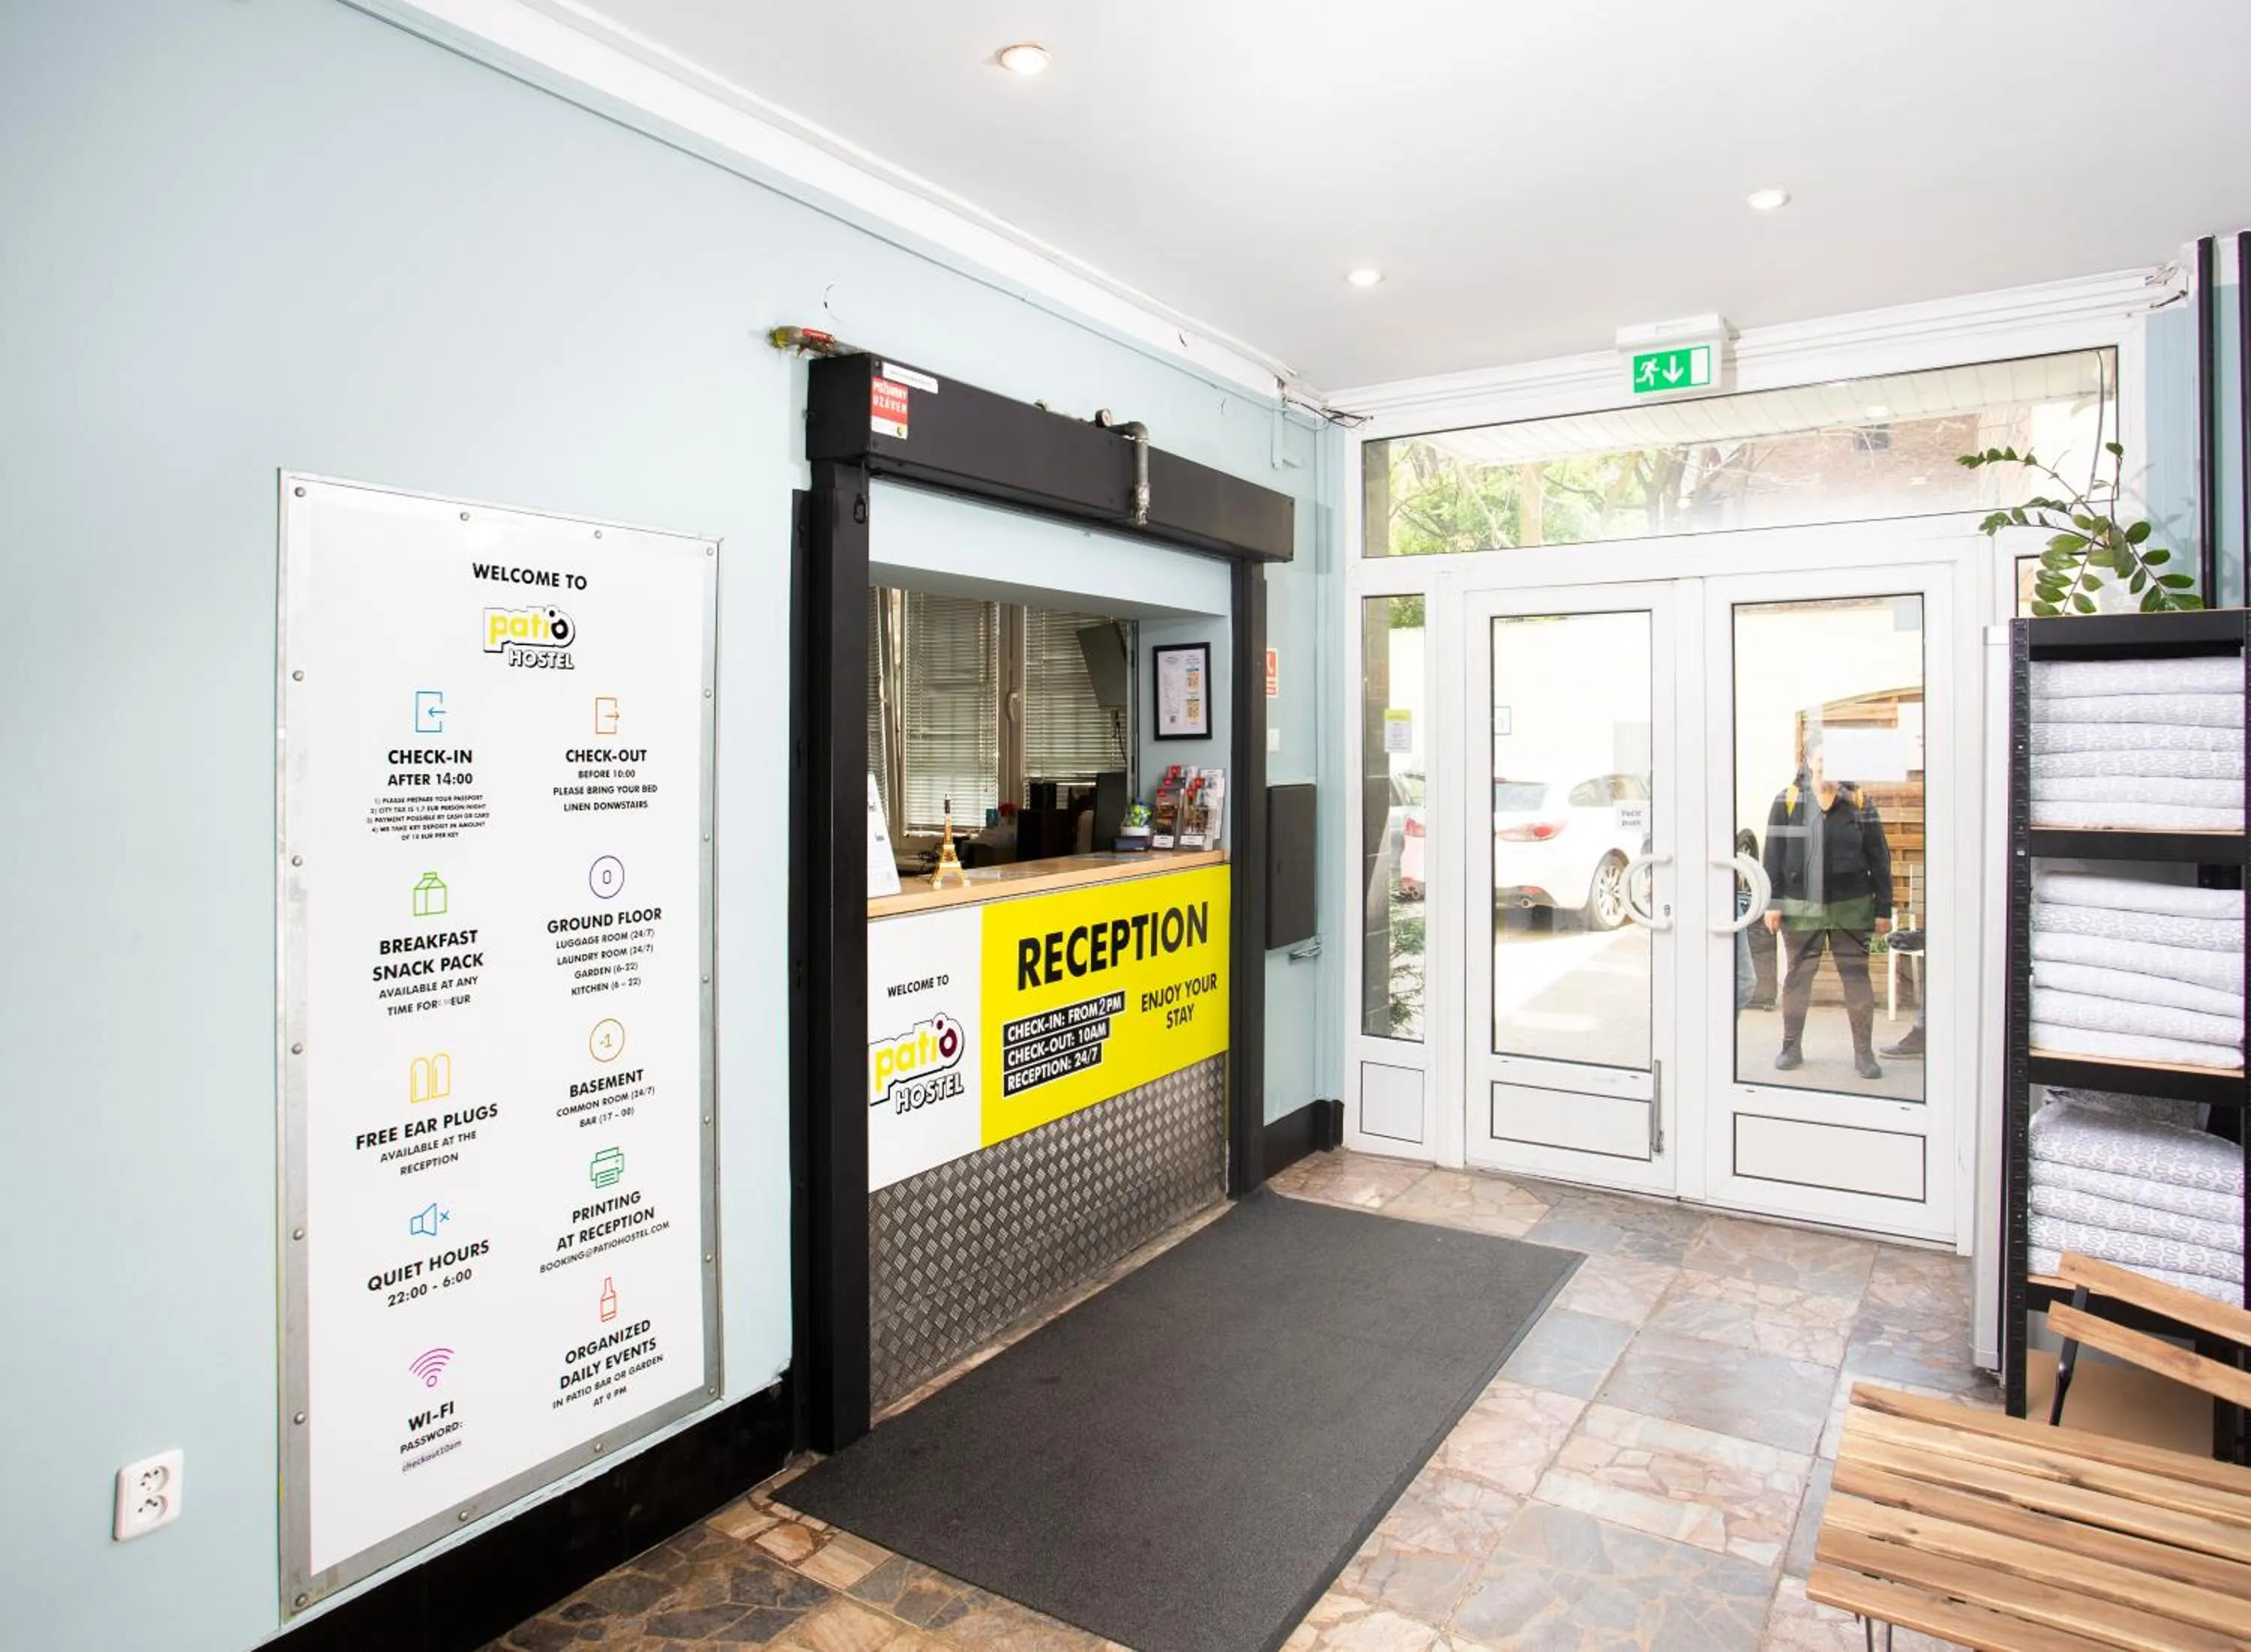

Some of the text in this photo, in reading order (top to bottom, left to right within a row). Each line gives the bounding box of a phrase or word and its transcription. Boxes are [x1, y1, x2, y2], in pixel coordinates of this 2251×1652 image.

[473, 563, 587, 590] WELCOME TO
[490, 610, 569, 644] patio
[509, 649, 575, 669] HOSTEL
[388, 749, 473, 764] CHECK-IN
[566, 749, 647, 762] CHECK-OUT
[388, 773, 473, 785] AFTER 14:00
[579, 770, 636, 779] BEFORE 10:00
[553, 786, 584, 795] PLEASE
[587, 785, 614, 794] BRING
[642, 785, 657, 793] BED
[564, 800, 648, 812] LINEN DONWSTAIRS
[547, 908, 662, 933] GROUND FLOOR
[380, 930, 478, 955] BREAKFAST
[557, 929, 654, 949] LUGGAGE ROOM (24/7)
[1018, 901, 1209, 991] RECEPTION
[373, 953, 484, 981] SNACK PACK
[557, 945, 654, 966] LAUNDRY ROOM (24/7)
[575, 966, 612, 979] GARDEN
[888, 975, 949, 998] WELCOME TO
[379, 976, 478, 999] AVAILABLE AT ANY
[571, 983, 609, 996] KITCHEN
[1141, 972, 1217, 1013] ENJOY YOUR
[387, 1004, 413, 1016] TIME
[417, 1000, 437, 1011] FOR
[451, 995, 470, 1005] EUR
[1167, 1003, 1195, 1029] STAY
[1008, 1013, 1065, 1042] CHECK-IN:
[1068, 1002, 1097, 1024] FROM
[876, 1020, 957, 1092] patio
[1008, 1022, 1106, 1066] CHECK-OUT: 10AM
[1008, 1047, 1098, 1091] RECEPTION: 24/7
[570, 1069, 644, 1098] BASEMENT
[896, 1072, 964, 1115] HOSTEL
[557, 1086, 655, 1117] COMMON ROOM (24/7)
[356, 1103, 498, 1149] FREE EAR PLUGS
[579, 1116, 597, 1127] BAR
[380, 1131, 477, 1163] AVAILABLE AT THE
[400, 1152, 458, 1176] RECEPTION
[573, 1191, 641, 1224] PRINTING
[557, 1206, 654, 1251] AT RECEPTION
[539, 1221, 670, 1273] BOOKING@PATIOHOSTEL.COM
[368, 1239, 490, 1291] QUIET HOURS
[388, 1284, 427, 1307] 22:00
[443, 1269, 472, 1287] 6:00
[565, 1320, 651, 1364] ORGANIZED
[560, 1338, 657, 1389] DAILY EVENTS
[552, 1354, 663, 1409] IN PATIO BAR OR GARDEN
[594, 1397, 603, 1407] AT
[614, 1386, 627, 1397] PM
[408, 1401, 454, 1431] WI-FI
[400, 1421, 463, 1454] PASSWORD:
